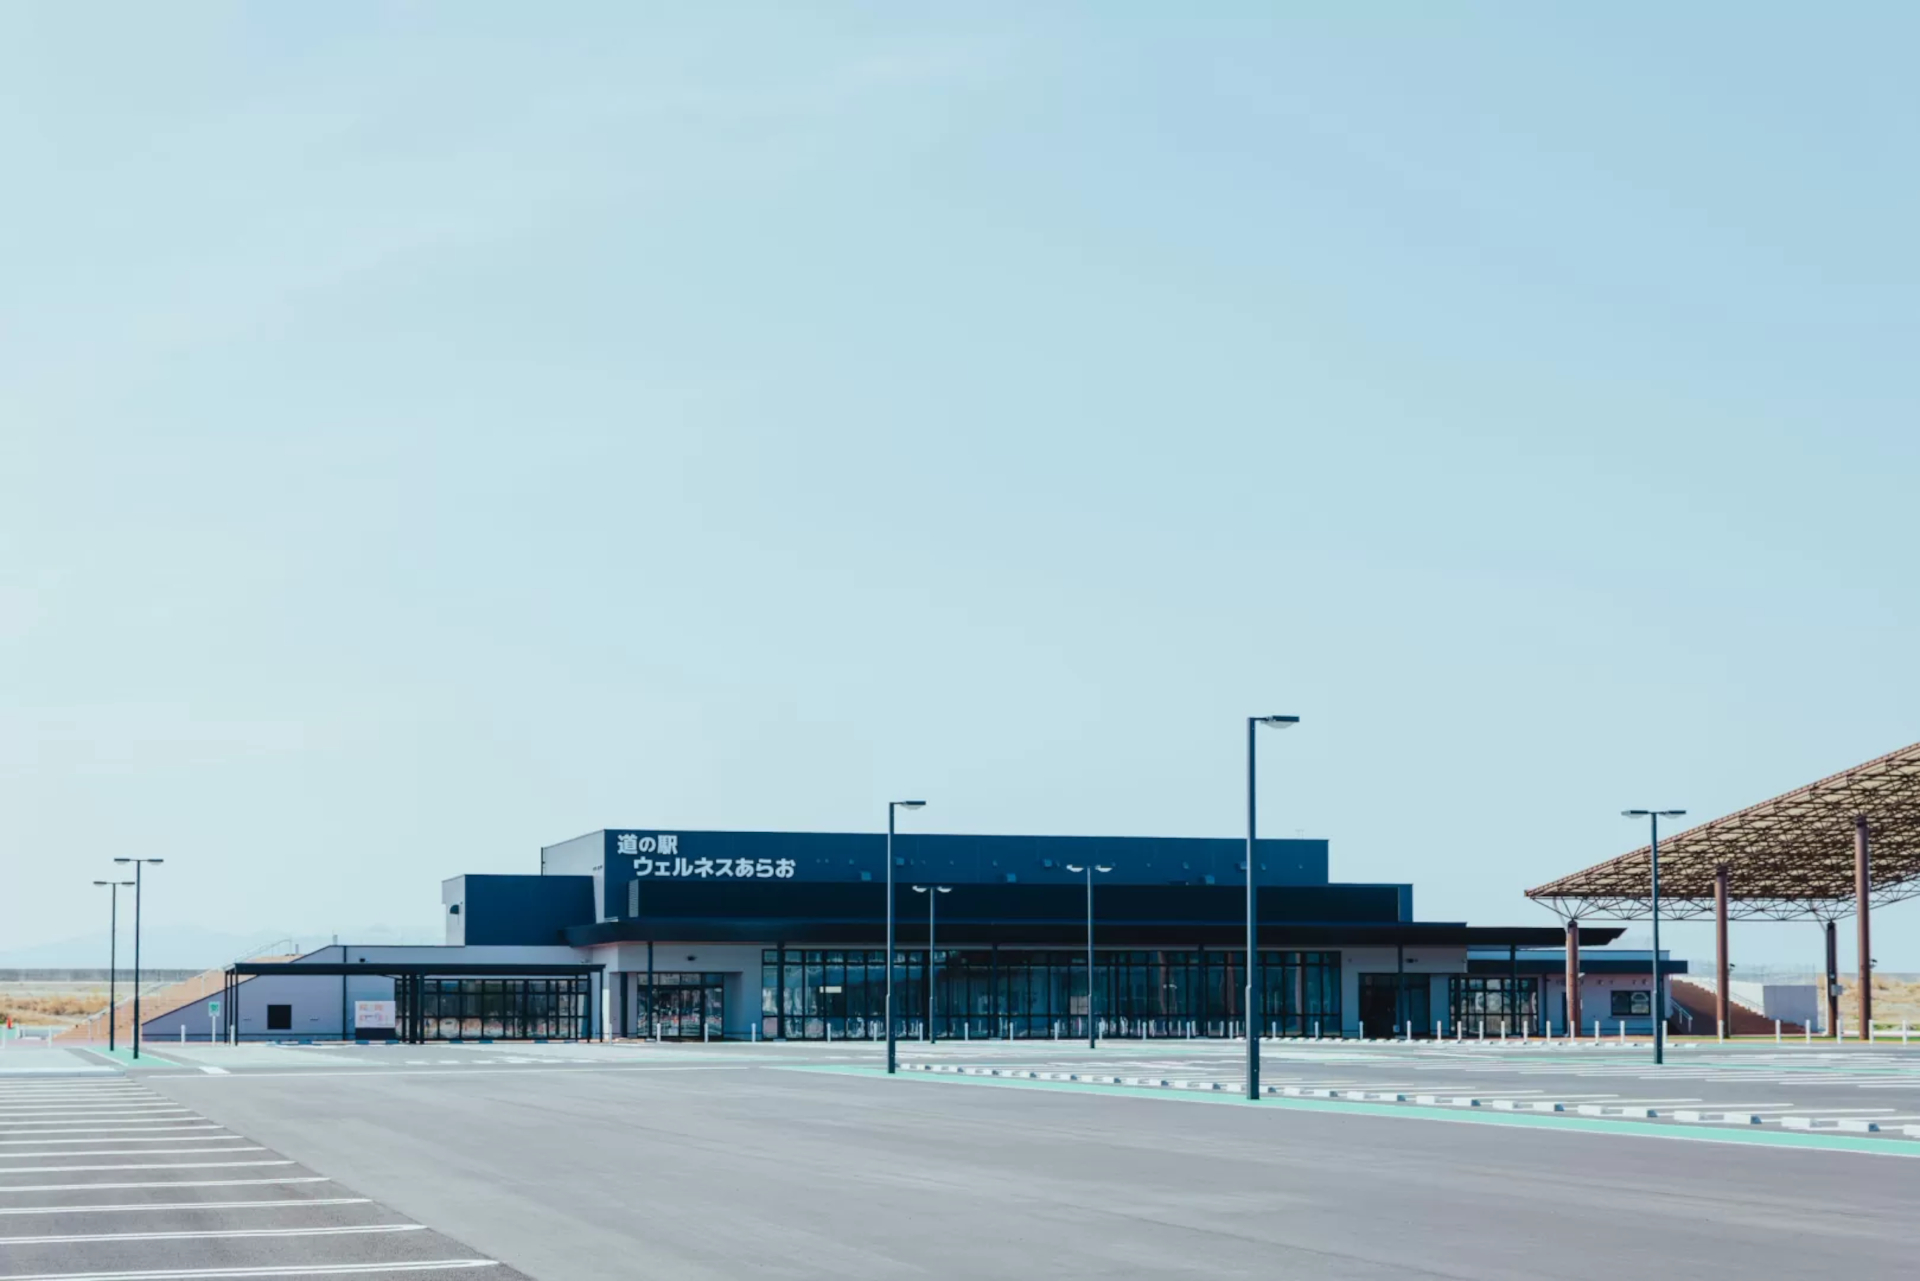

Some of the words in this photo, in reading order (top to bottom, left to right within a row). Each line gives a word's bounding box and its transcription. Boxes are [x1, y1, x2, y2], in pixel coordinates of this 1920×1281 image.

[617, 833, 678, 855] 道の駅
[633, 856, 796, 878] ウェルネスあらお
